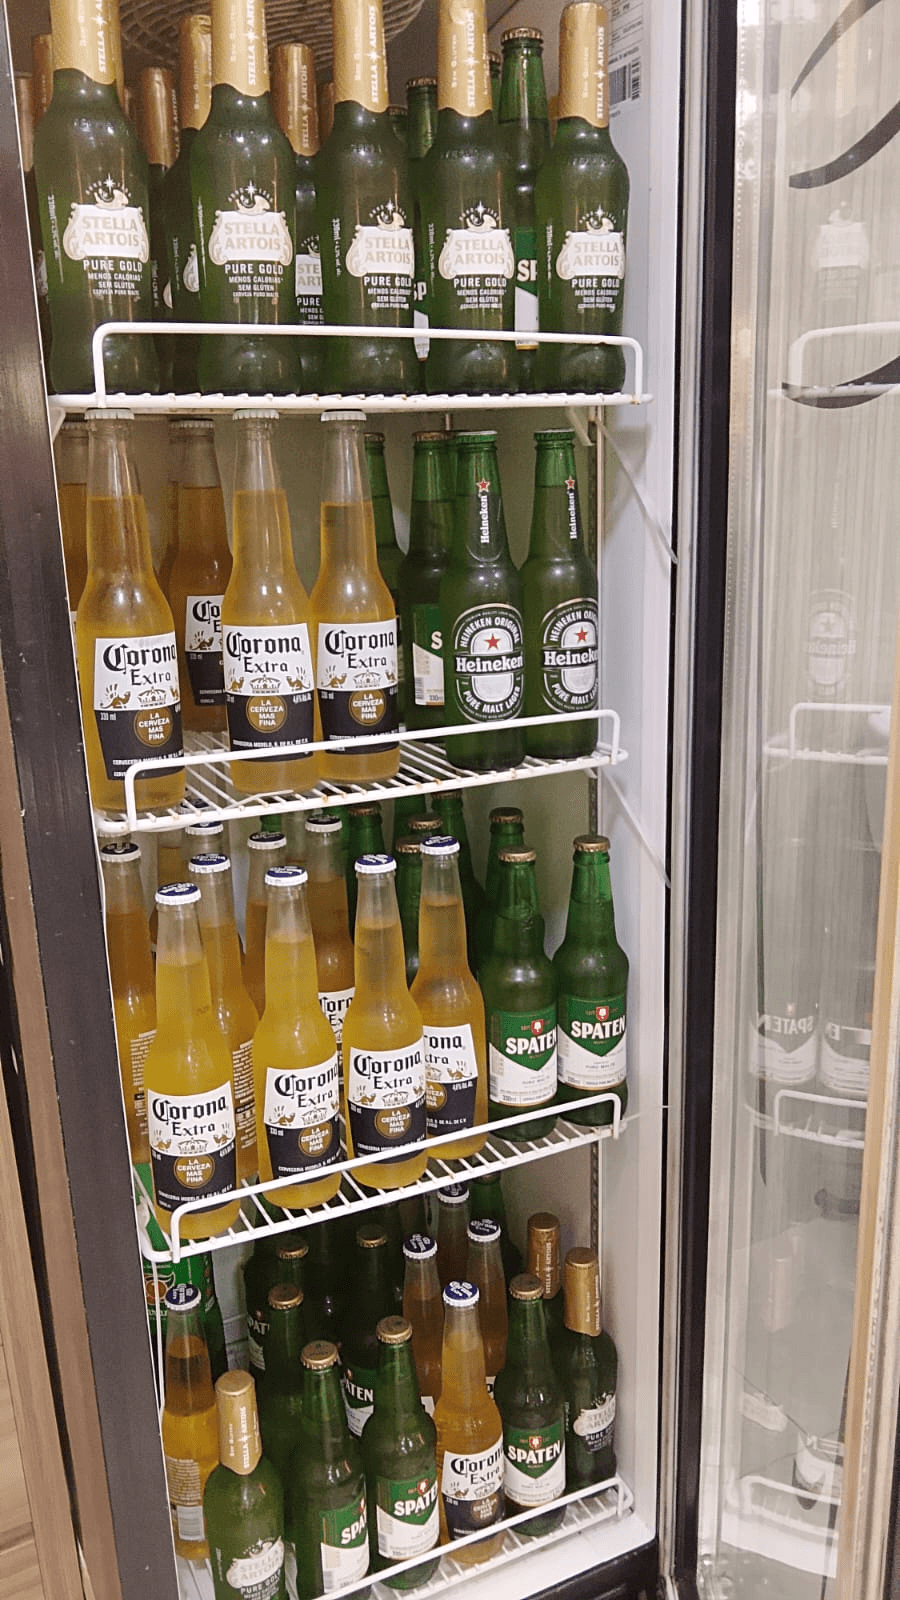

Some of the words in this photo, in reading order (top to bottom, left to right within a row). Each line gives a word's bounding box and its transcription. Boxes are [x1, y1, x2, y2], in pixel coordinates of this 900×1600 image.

[368, 6, 377, 48] ARTOIS
[300, 64, 308, 100] ARTOIS
[467, 69, 475, 107] STELLA
[82, 216, 138, 231] STELLA
[224, 222, 280, 236] STELLA
[82, 232, 139, 247] ARTOIS
[225, 237, 280, 250] ARTOIS
[365, 237, 410, 250] STELLA
[455, 240, 504, 251] STELLA
[574, 241, 620, 253] STELLA
[365, 251, 410, 264] ARTOIS
[455, 253, 504, 264] ARTOIS
[573, 255, 619, 266] ARTOIS
[83, 260, 114, 270] PURE
[119, 261, 143, 272] GOLD
[225, 263, 254, 274] PURE
[258, 264, 284, 275] GOLD
[364, 276, 391, 286] PURE
[454, 278, 481, 288] PURE
[485, 278, 507, 287] GOLD
[572, 278, 598, 288] PURE
[297, 297, 320, 306] PURE
[480, 495, 490, 544] Heineken
[568, 492, 577, 539] Heineken
[459, 617, 493, 648] HEINEKEN
[494, 617, 520, 644] ORIGINAL
[550, 610, 582, 642] HEINEKEN
[226, 632, 301, 661] Corona
[325, 629, 394, 658] Corona
[103, 643, 176, 675] Corona
[244, 657, 288, 673] Extra
[347, 653, 387, 669] Extra
[455, 655, 524, 673] Heineken
[130, 669, 171, 686] Extra
[463, 690, 480, 711] PURE
[482, 703, 504, 714] MALT
[505, 685, 521, 709] LAGER
[551, 683, 570, 703] PURE
[571, 694, 589, 705] MALT
[352, 698, 384, 707] CERVEZA
[138, 718, 169, 728] CERVEZA
[361, 712, 377, 720] FINA
[148, 733, 164, 741] FINA
[571, 1015, 626, 1040] SPATEN
[353, 1051, 421, 1079] Corona
[373, 1075, 413, 1089] Extra
[297, 1089, 333, 1108] Extra
[152, 1096, 226, 1126] Corona
[381, 1113, 410, 1123] CERVEZA
[172, 1121, 216, 1137] Extra
[300, 1129, 329, 1142] CERVEZA
[177, 1163, 211, 1171] CERVEZA
[186, 1175, 203, 1183] FINA
[507, 1440, 562, 1465] SPATEN
[241, 1580, 264, 1595] PURE
